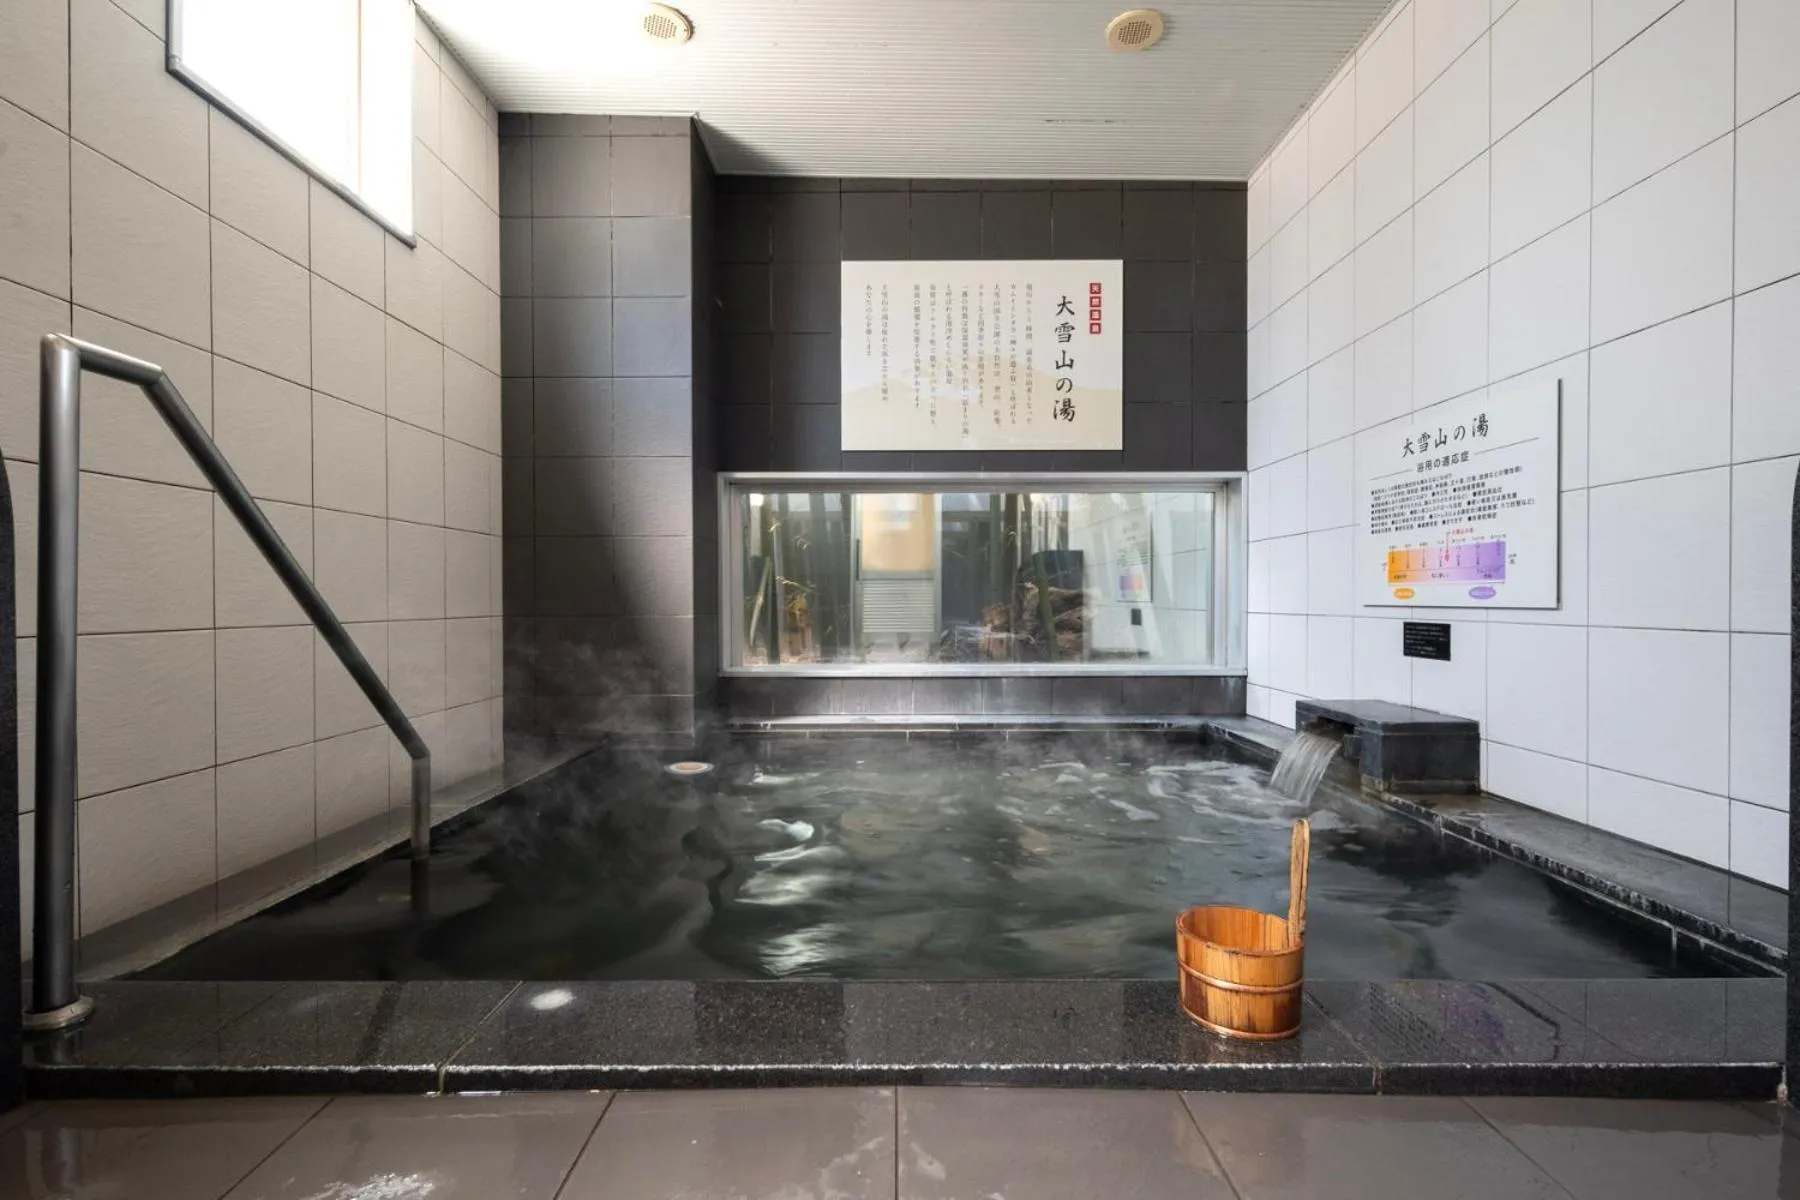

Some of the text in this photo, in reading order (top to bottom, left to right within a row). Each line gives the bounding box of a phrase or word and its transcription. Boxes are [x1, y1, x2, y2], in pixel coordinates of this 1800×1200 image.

[1053, 295, 1076, 422] 大雪山の湯
[1402, 413, 1489, 458] 大雪山の湯
